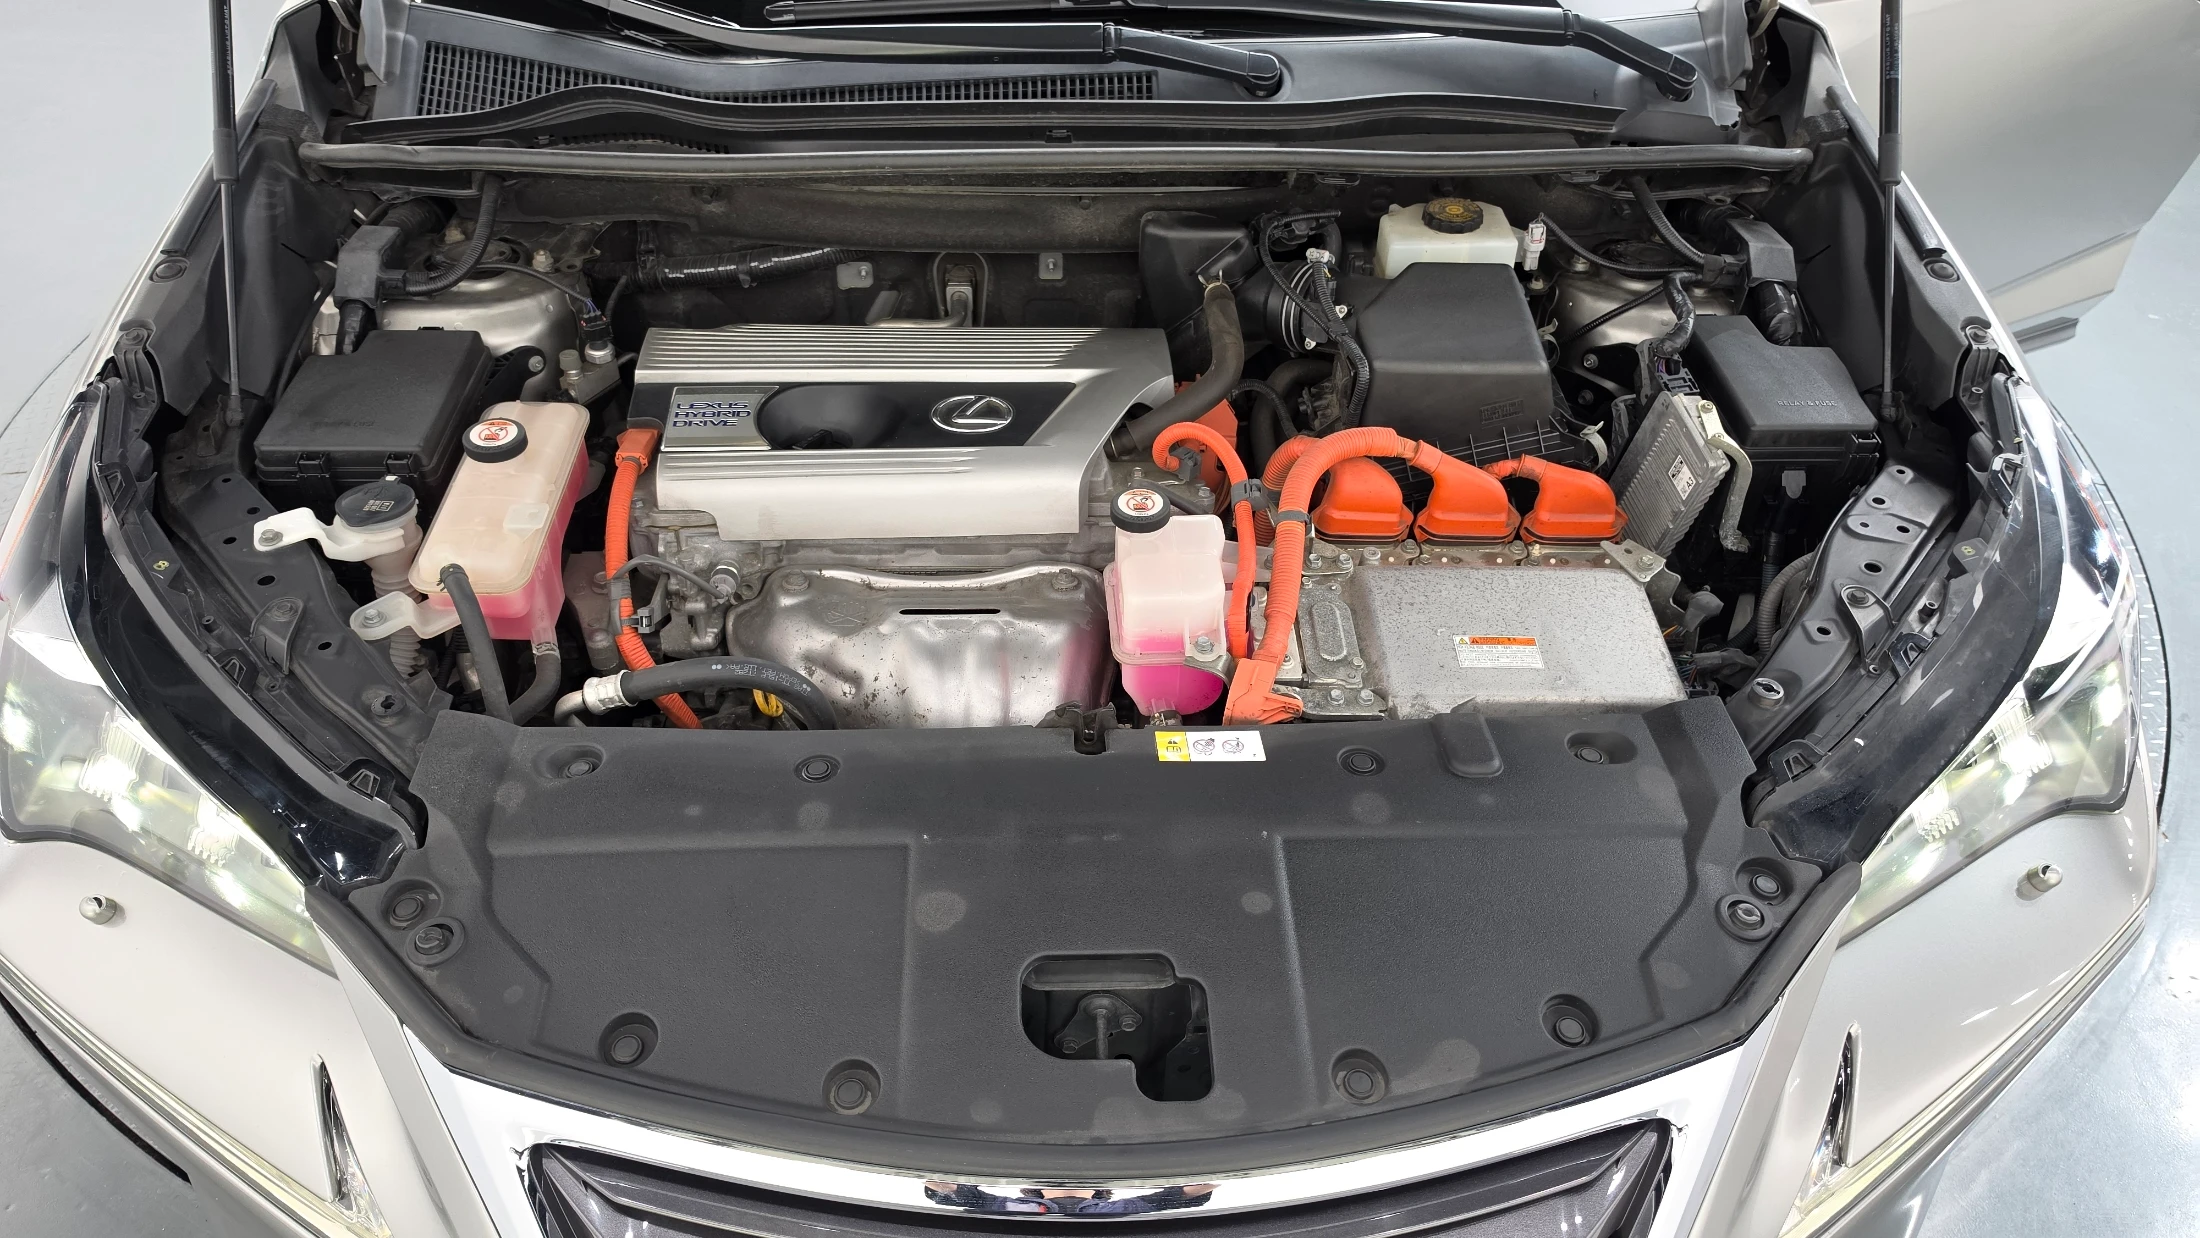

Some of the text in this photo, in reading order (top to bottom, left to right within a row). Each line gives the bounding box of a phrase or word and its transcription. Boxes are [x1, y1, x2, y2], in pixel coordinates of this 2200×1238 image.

[677, 401, 749, 409] LEXUS
[674, 410, 751, 418] HYBRID
[672, 419, 738, 427] DRIVE
